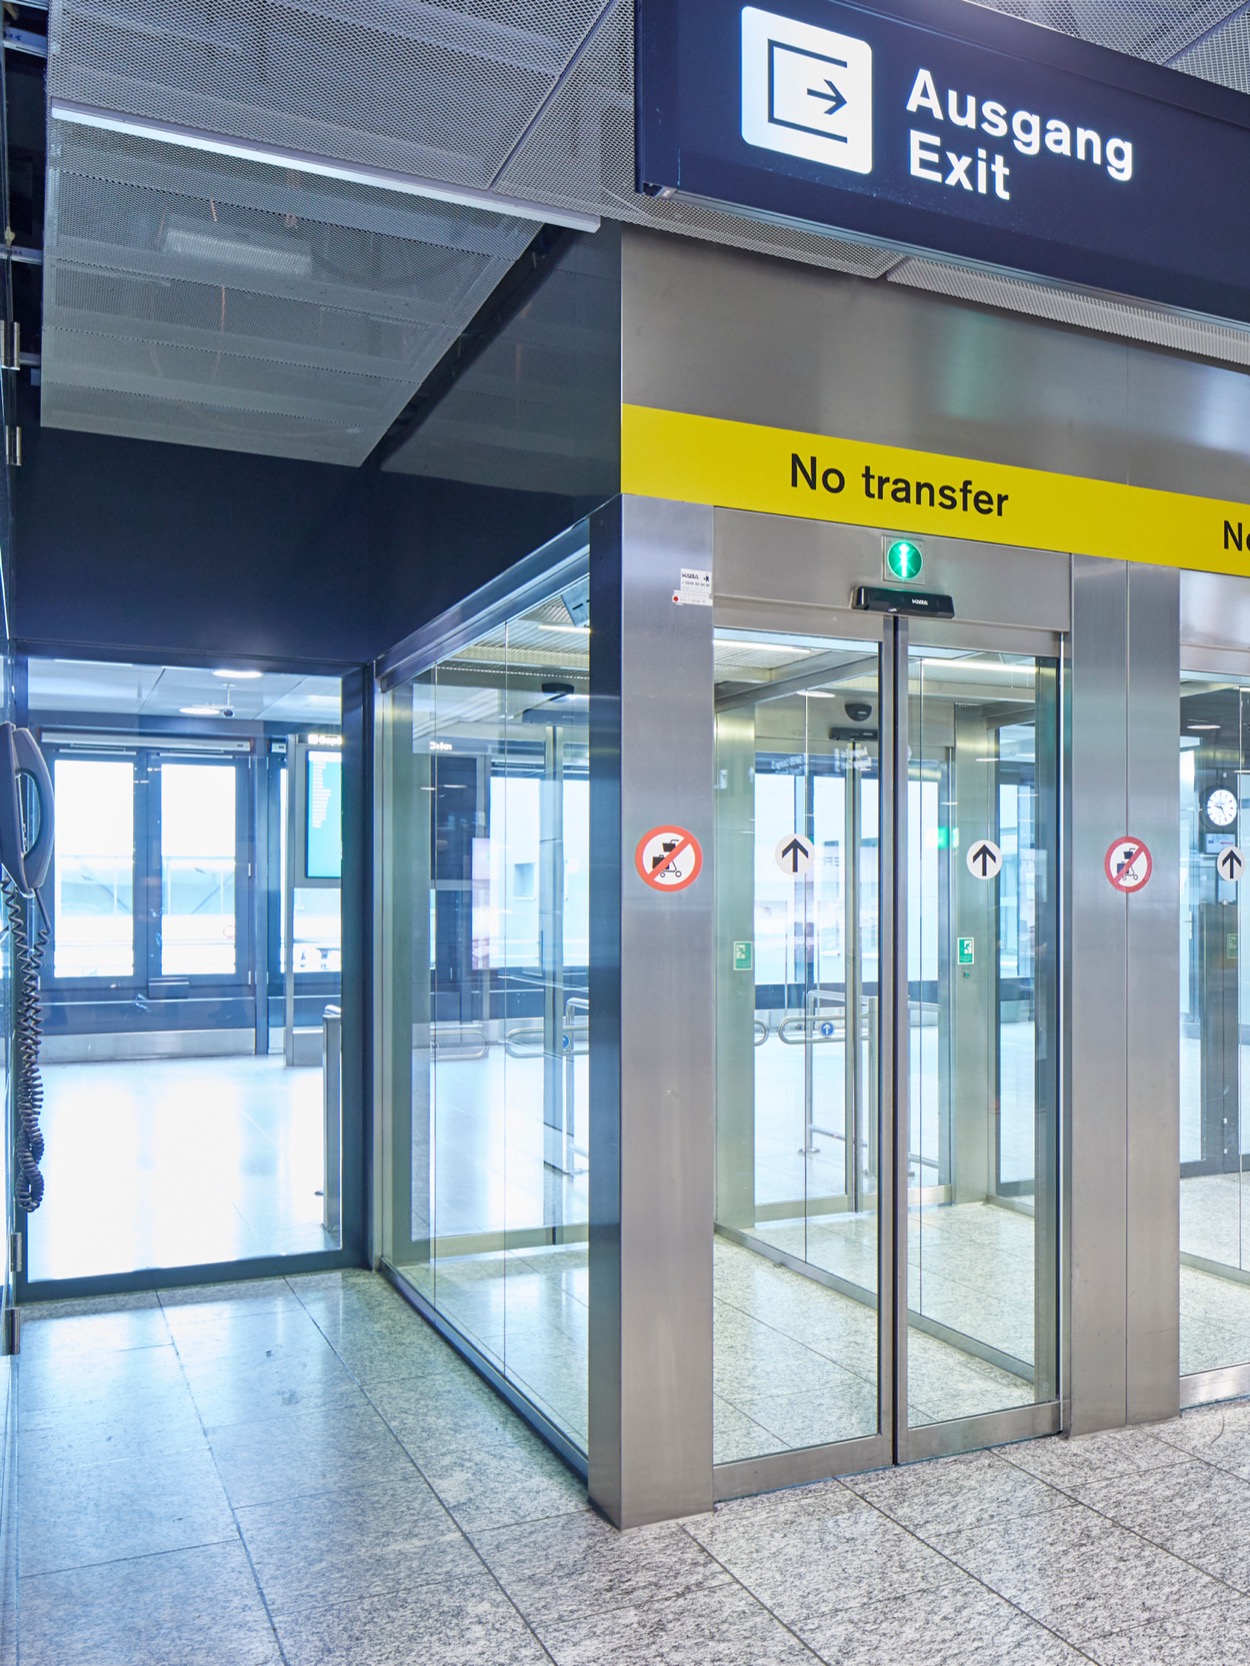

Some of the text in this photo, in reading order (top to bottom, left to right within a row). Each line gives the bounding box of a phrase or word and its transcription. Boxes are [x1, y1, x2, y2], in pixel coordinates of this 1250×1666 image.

[905, 68, 1133, 182] Ausgang
[909, 128, 1010, 201] Exit
[790, 452, 1009, 517] No transfer
